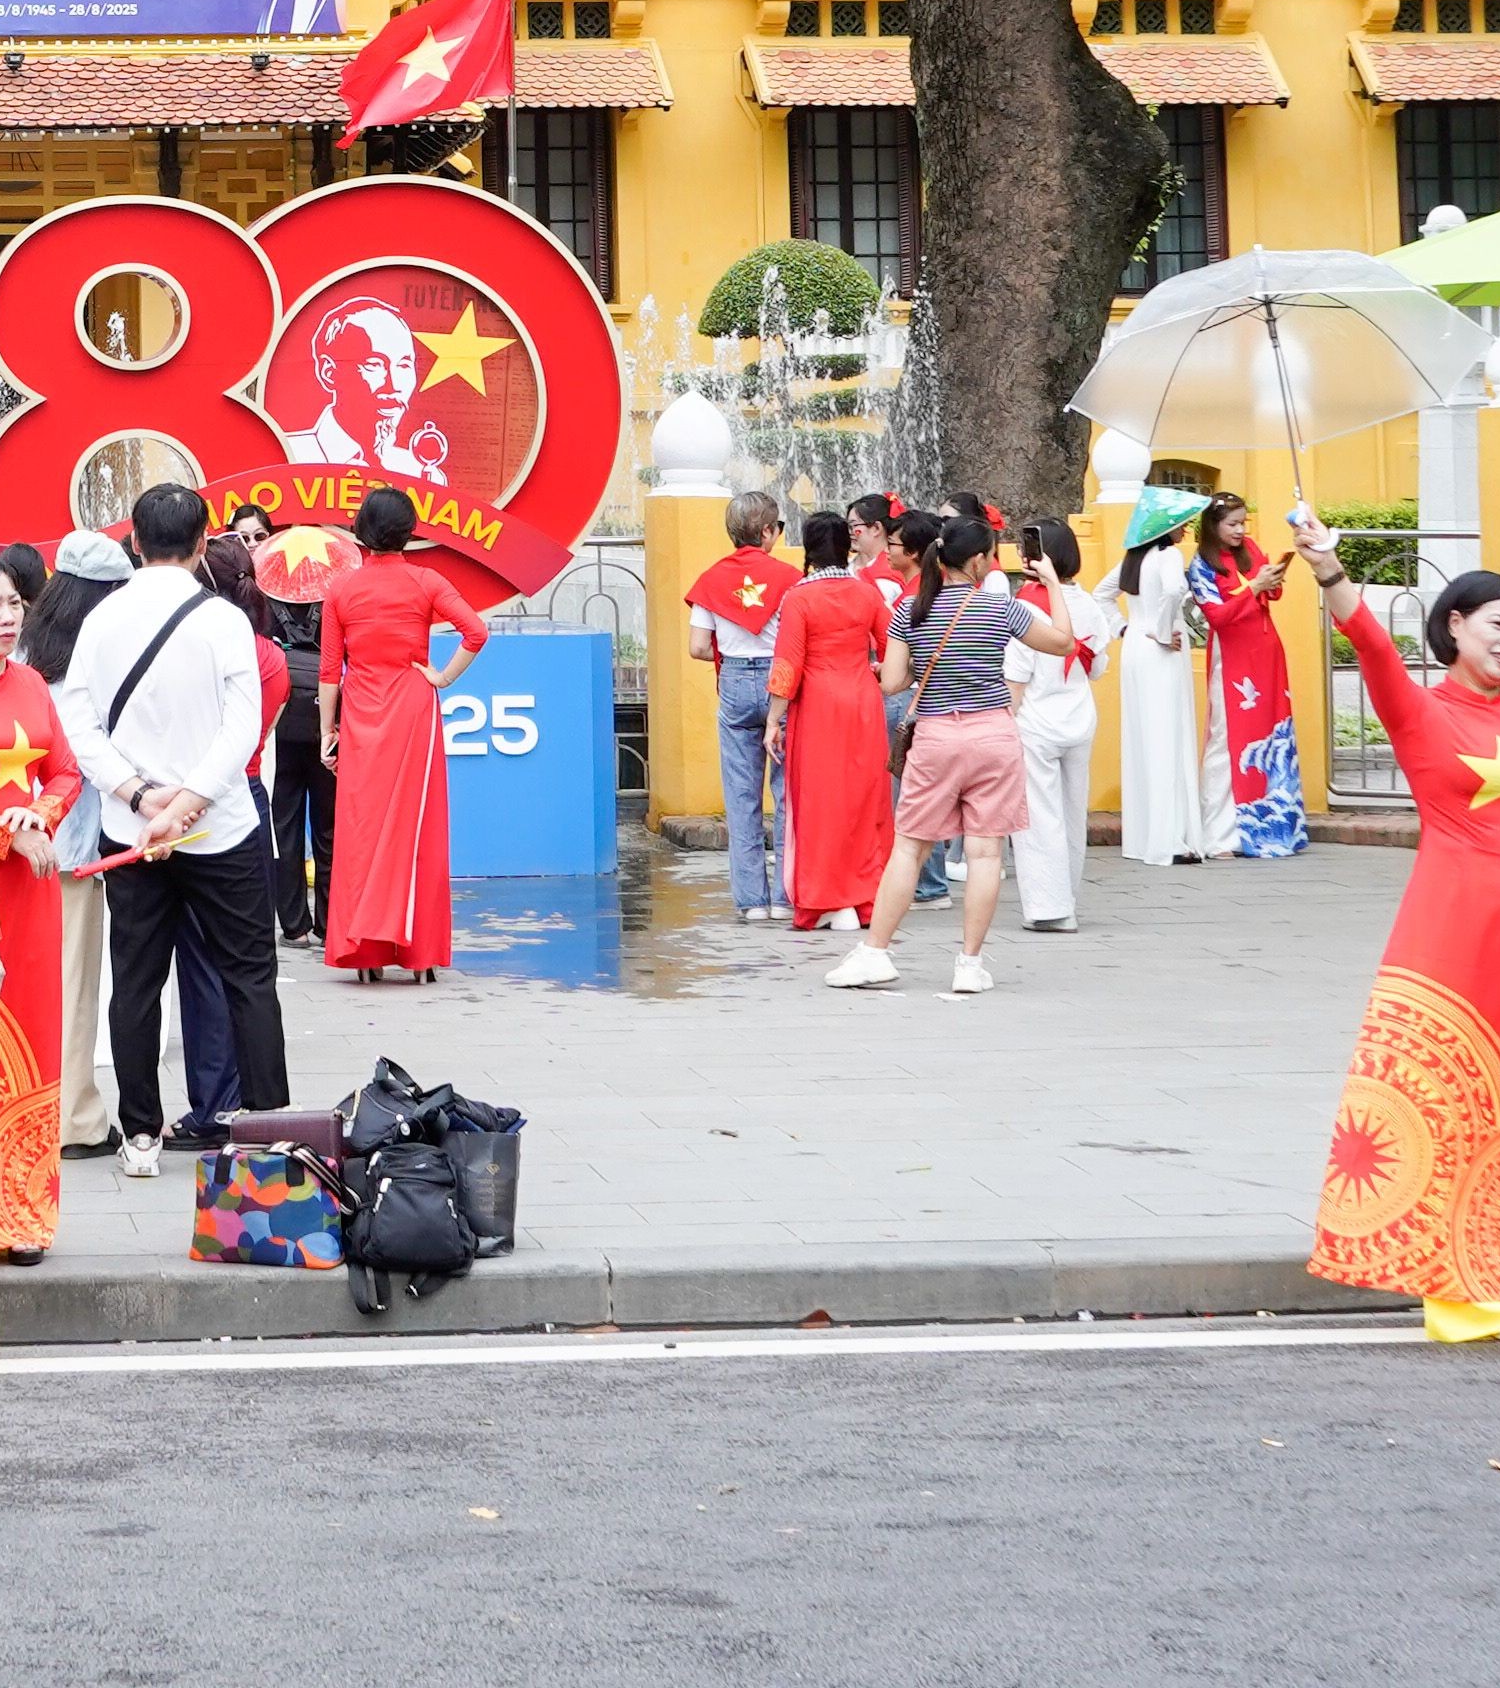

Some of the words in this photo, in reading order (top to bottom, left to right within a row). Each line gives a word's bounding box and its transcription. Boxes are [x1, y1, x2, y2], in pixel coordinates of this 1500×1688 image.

[68, 3, 138, 16] 28/8/2025
[206, 480, 284, 531] IAO
[406, 486, 504, 551] NAM
